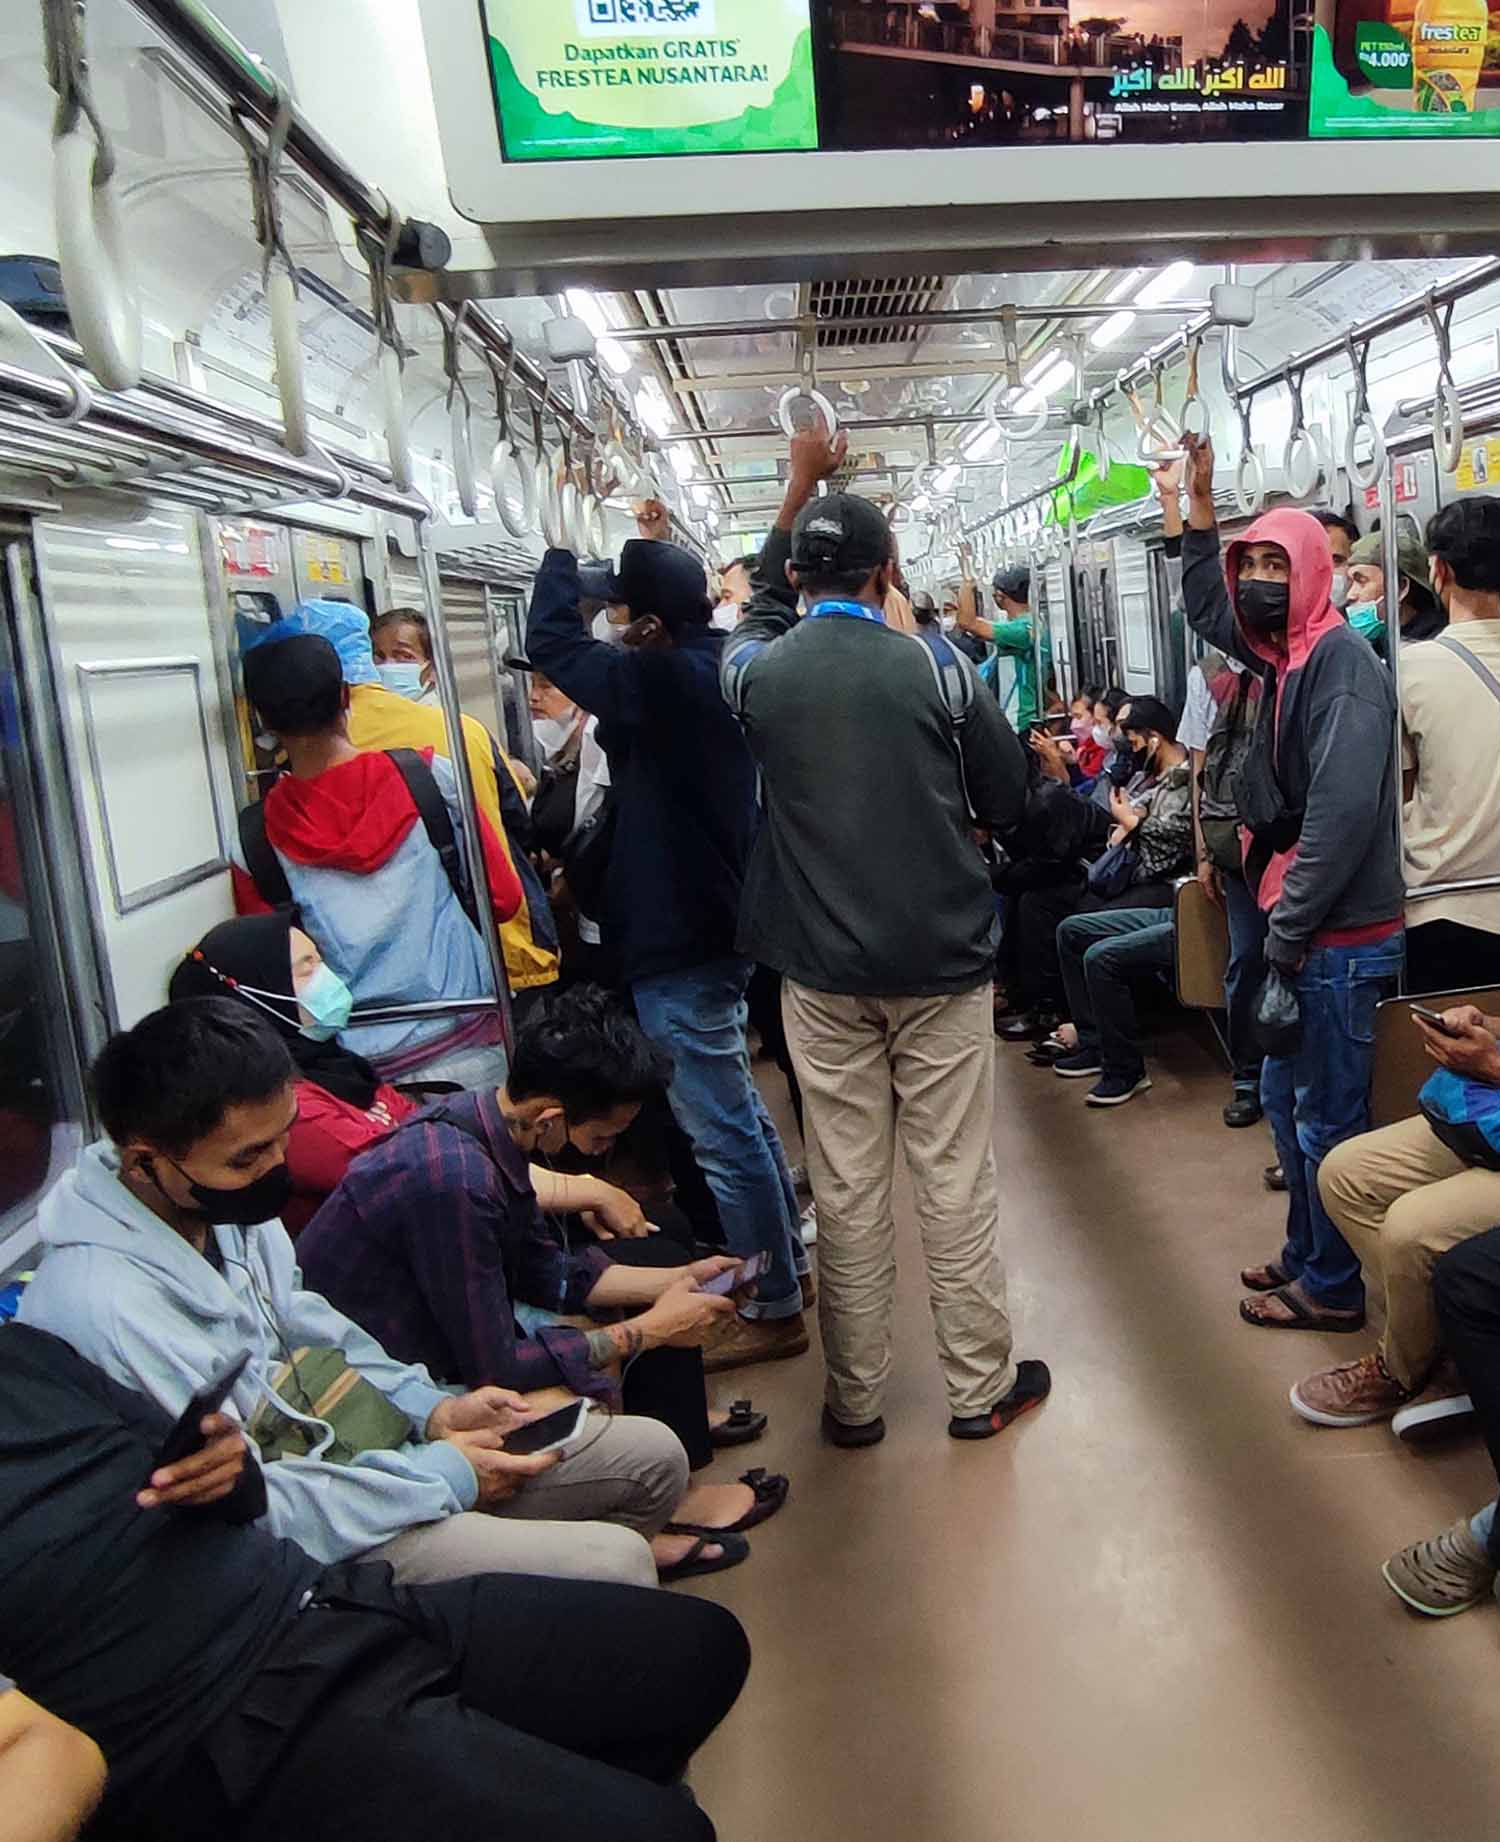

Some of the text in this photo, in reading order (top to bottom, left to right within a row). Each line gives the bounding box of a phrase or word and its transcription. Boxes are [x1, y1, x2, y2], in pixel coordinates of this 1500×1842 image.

[564, 43, 659, 64] Dapatkan
[536, 65, 769, 88] FRESTEA NUSANTARA!
